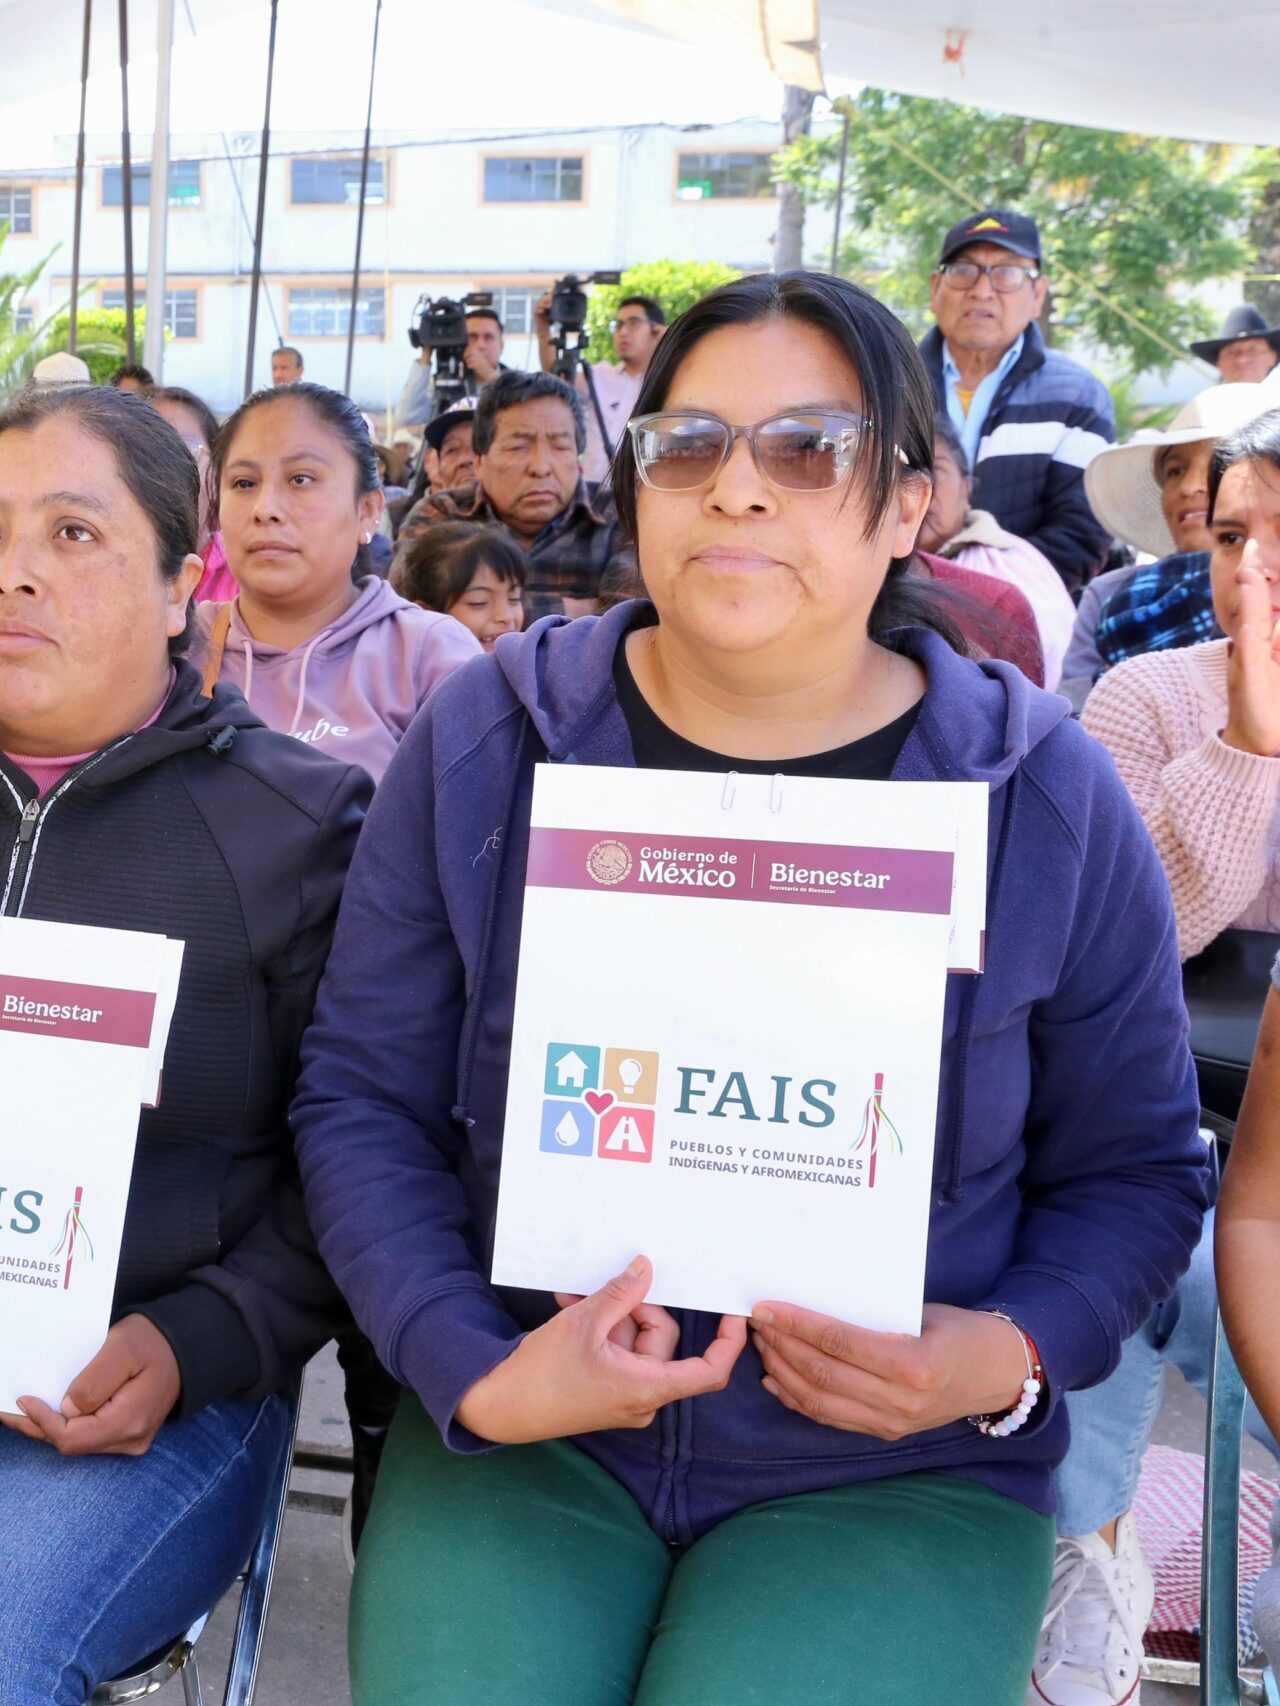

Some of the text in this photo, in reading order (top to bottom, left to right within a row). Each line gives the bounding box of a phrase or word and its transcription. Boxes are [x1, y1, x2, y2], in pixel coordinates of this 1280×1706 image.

[640, 847, 738, 864] Gobierno de
[638, 860, 736, 888] México
[770, 862, 890, 889] Bienestar
[2, 995, 103, 1023] Bienestar
[674, 1066, 836, 1128] FAIS
[670, 1140, 864, 1170] PUEBLOS Y COMUNIDADES
[668, 1156, 861, 1187] INDÍGENAS Y AFROMEXICANAS
